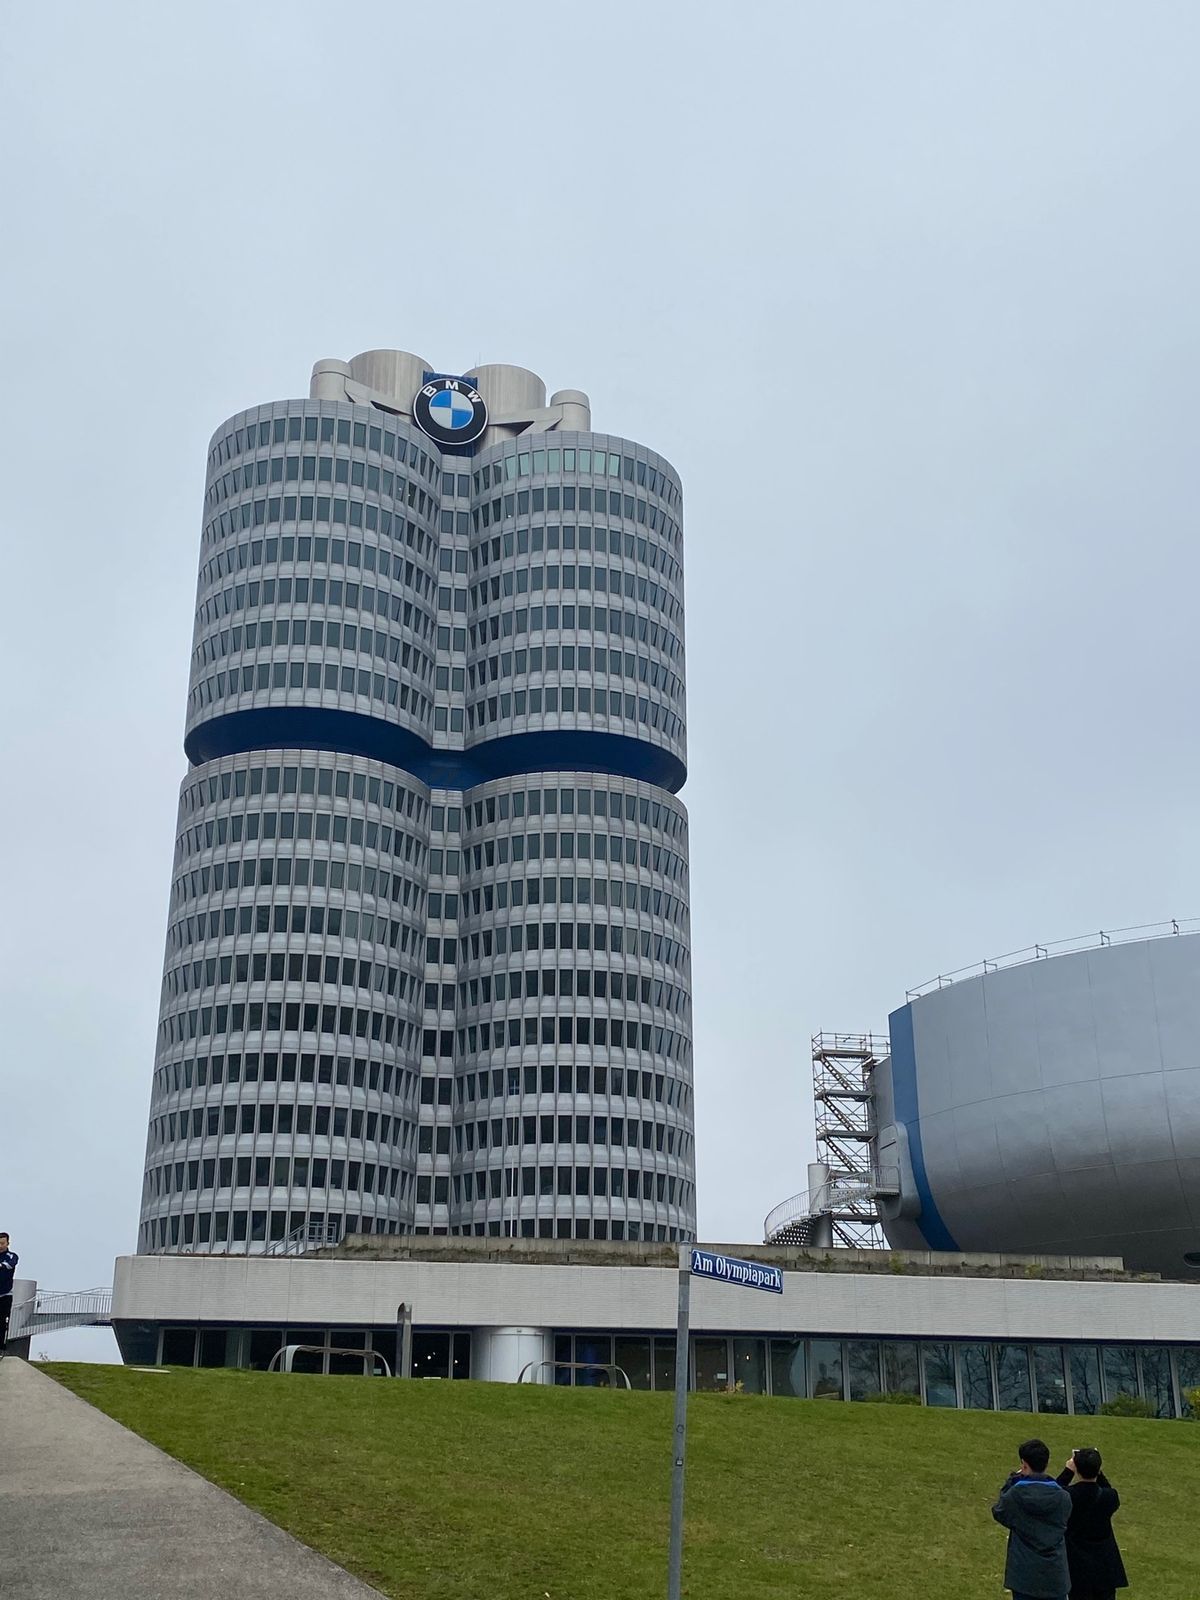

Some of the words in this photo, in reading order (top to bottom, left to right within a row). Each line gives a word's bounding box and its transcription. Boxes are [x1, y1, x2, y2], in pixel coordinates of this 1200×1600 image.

[422, 380, 481, 403] BMW
[693, 1253, 713, 1273] Am
[716, 1257, 781, 1287] Olympiapark
